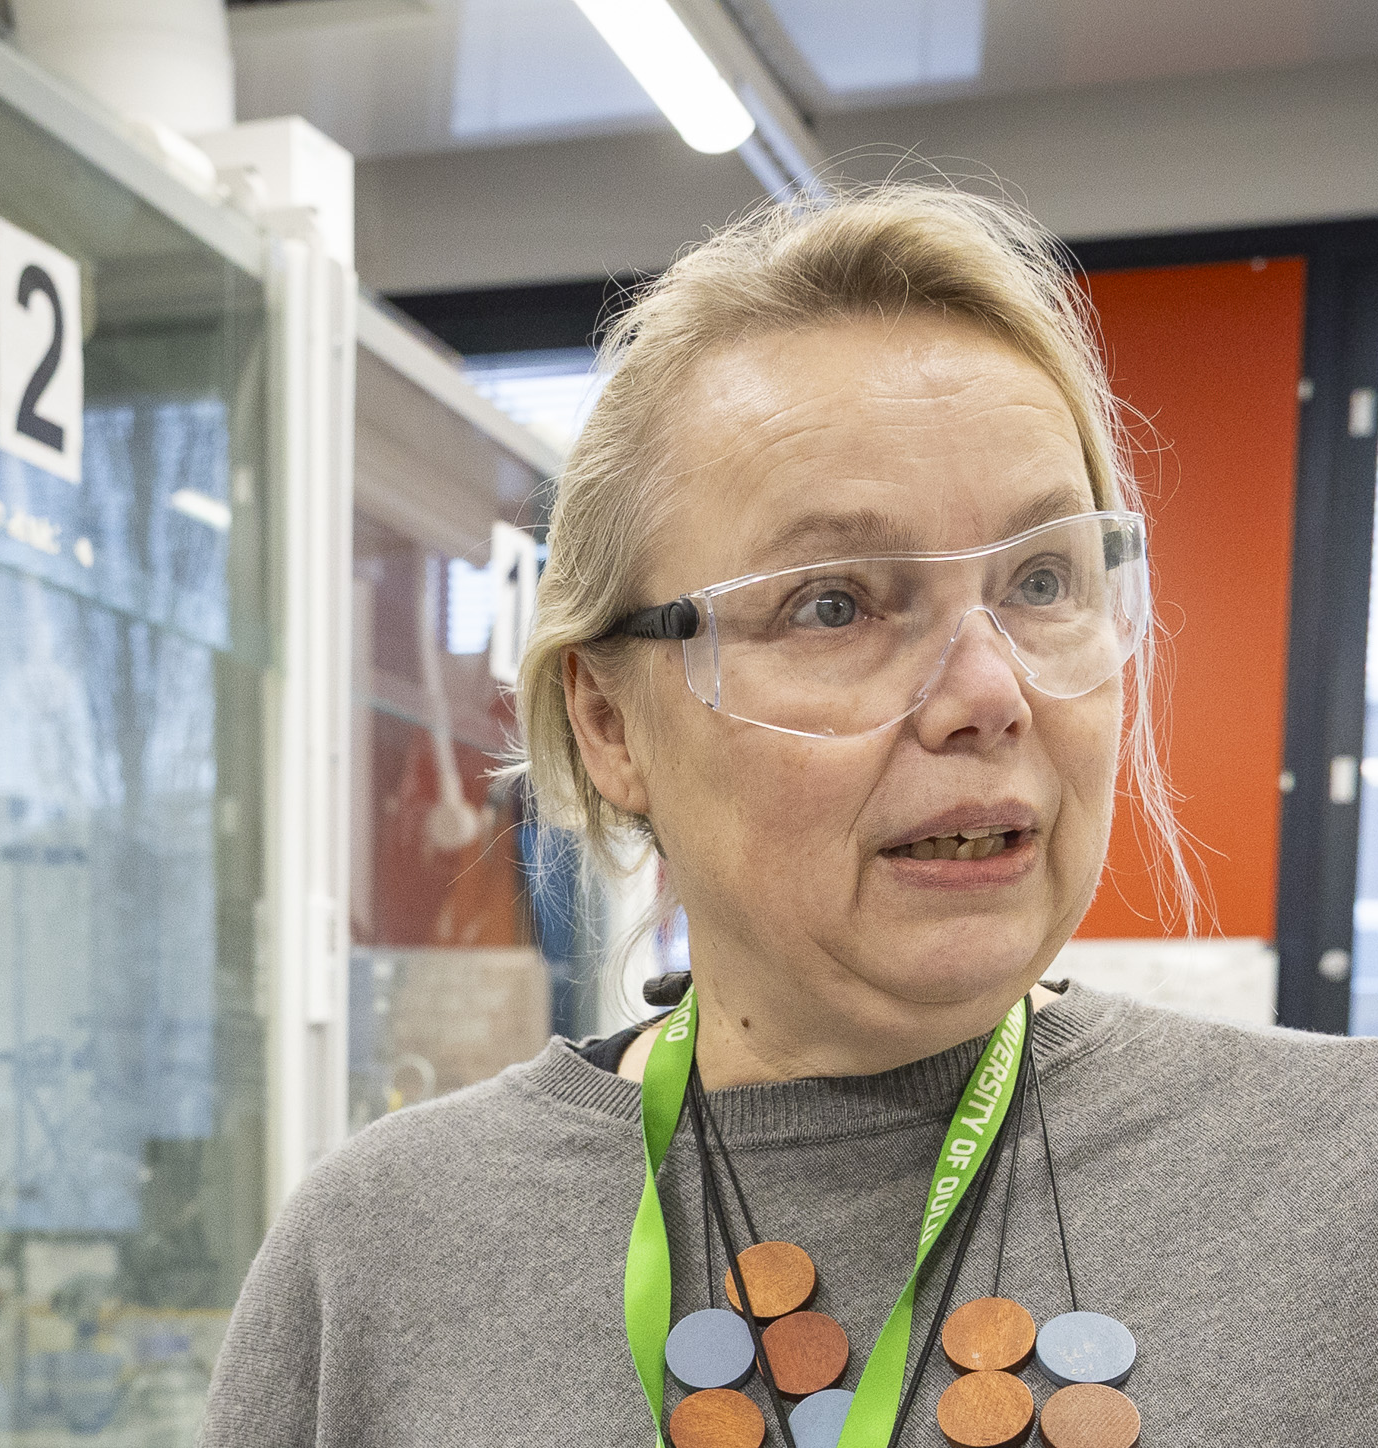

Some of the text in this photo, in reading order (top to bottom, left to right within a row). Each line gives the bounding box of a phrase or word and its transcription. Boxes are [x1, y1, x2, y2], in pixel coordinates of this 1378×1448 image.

[17, 264, 64, 453] 2
[946, 1137, 977, 1171] OF
[920, 1176, 960, 1246] OULU
